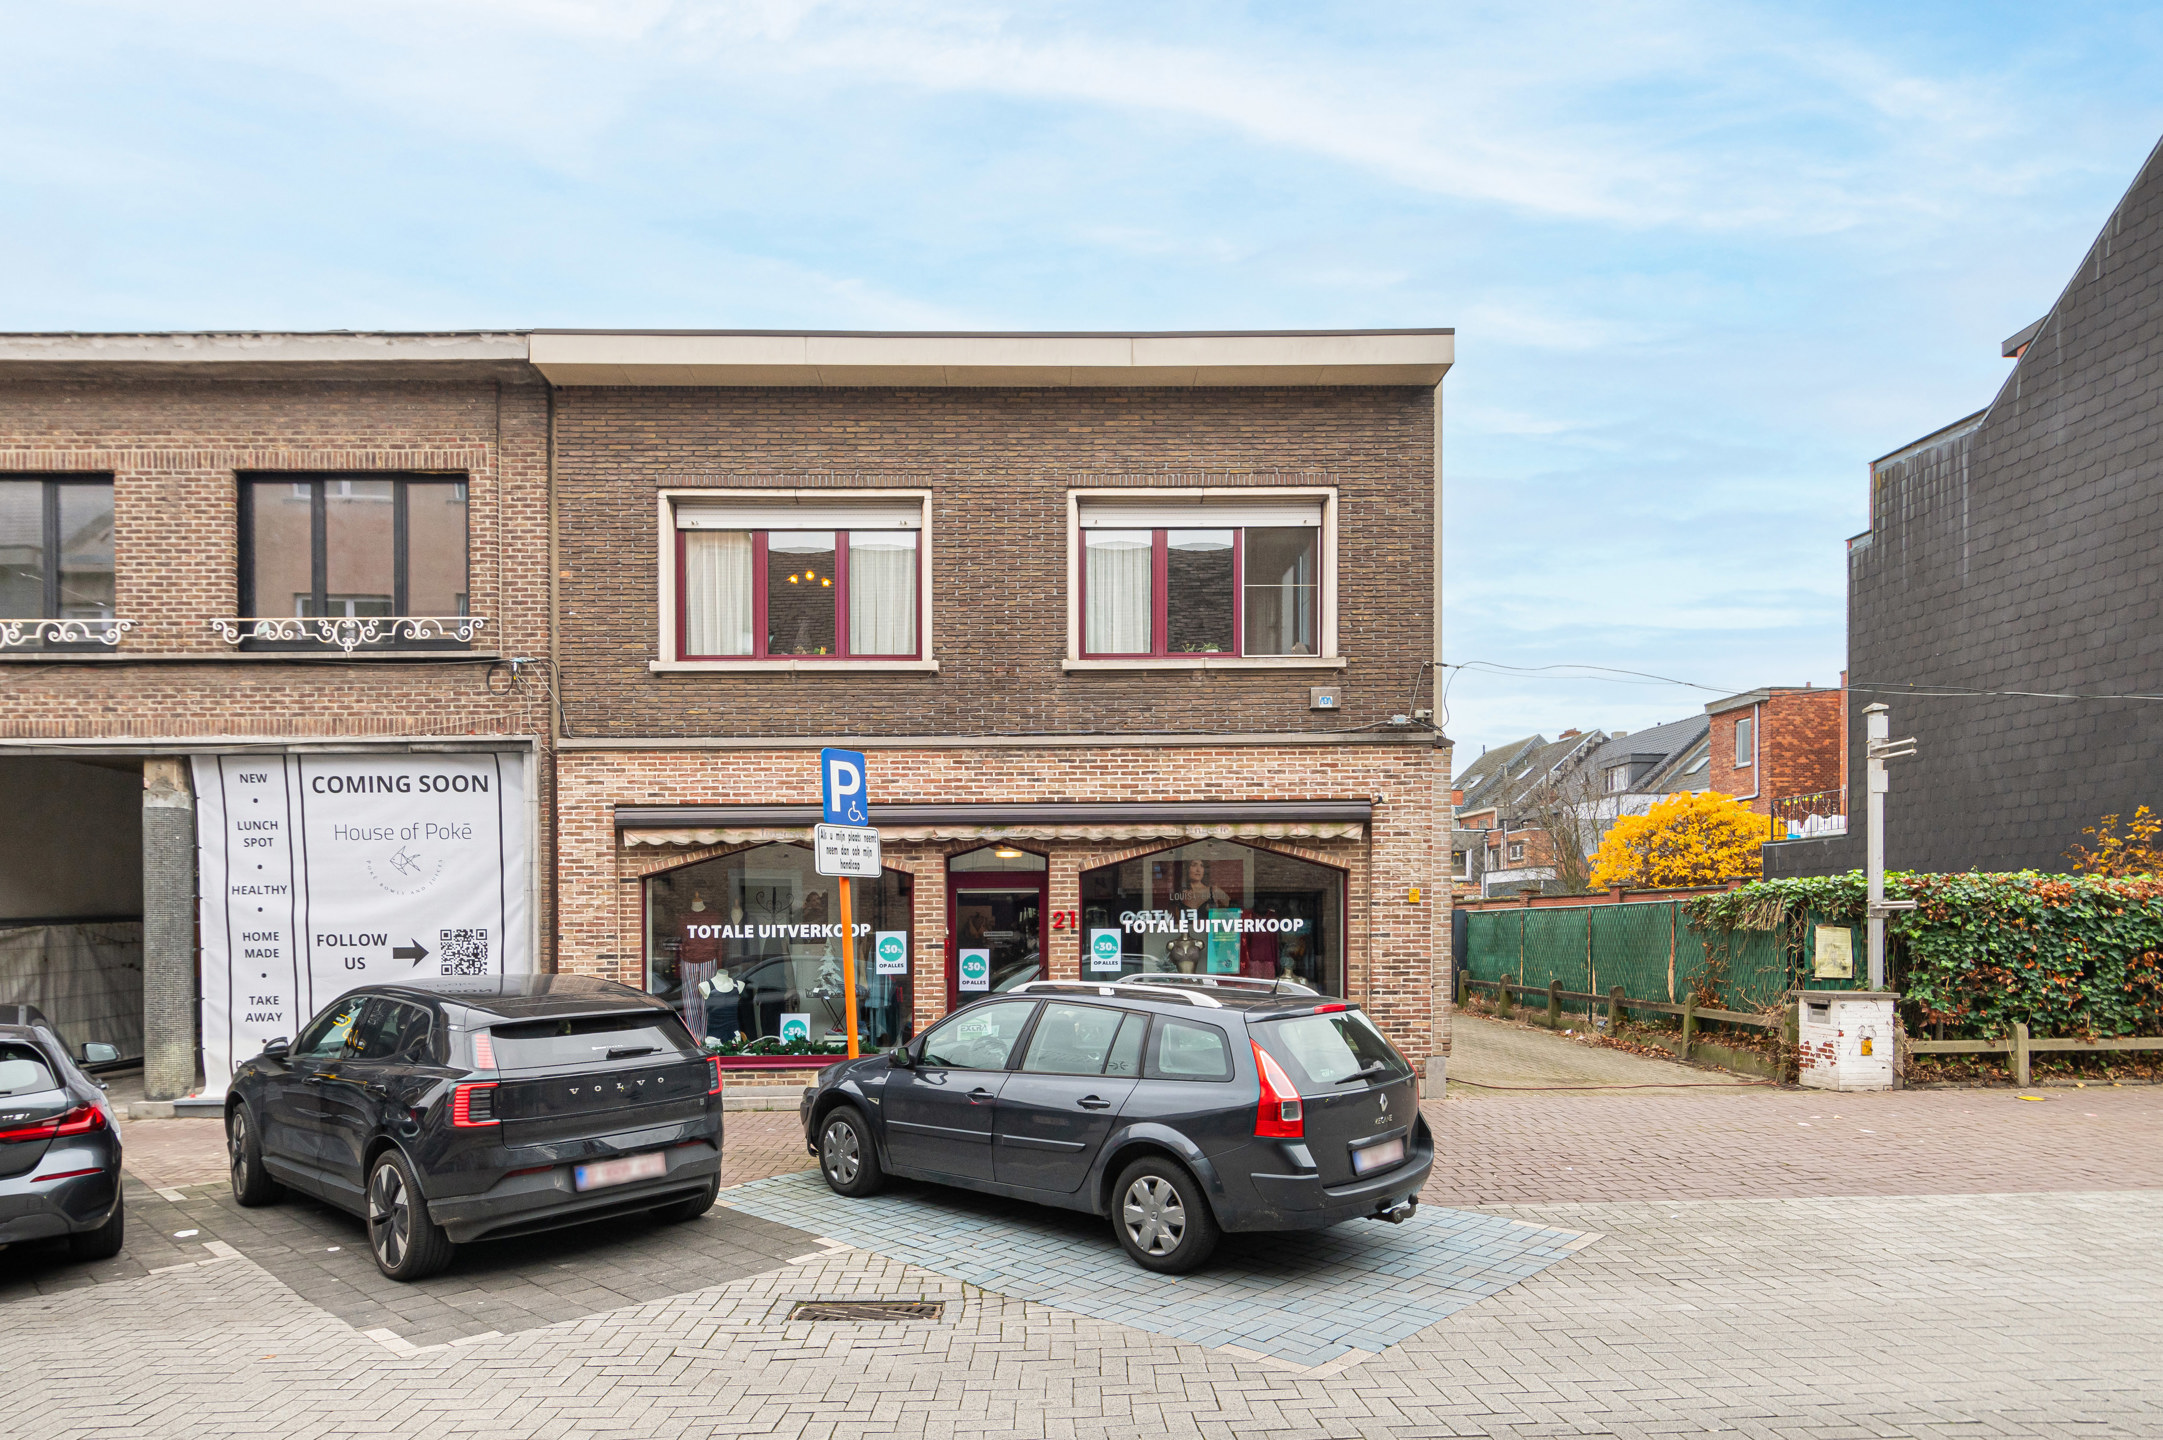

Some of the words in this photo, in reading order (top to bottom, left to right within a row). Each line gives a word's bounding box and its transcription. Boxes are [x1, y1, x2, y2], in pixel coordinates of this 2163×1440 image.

[239, 773, 268, 784] NEW
[311, 774, 412, 795] COMING
[418, 774, 490, 794] SOON
[829, 760, 861, 813] P
[236, 820, 279, 831] LUNCH
[334, 823, 395, 841] House
[399, 822, 420, 841] of
[243, 837, 274, 848] SPOT
[836, 830, 845, 843] mijn
[863, 846, 872, 858] mijn
[231, 884, 288, 896] HEALTHY
[1052, 910, 1076, 929] 21
[1122, 919, 1189, 934] TOTALE
[1193, 918, 1304, 934] UITVERKOOP
[242, 931, 280, 942] HOME
[687, 924, 754, 939] TOTALE
[316, 932, 388, 947] FOLLOW
[244, 948, 280, 959] MADE
[343, 955, 366, 971] US
[248, 995, 280, 1006] TAKE
[245, 1012, 283, 1023] AWAY
[569, 1077, 665, 1095] VOLVO
